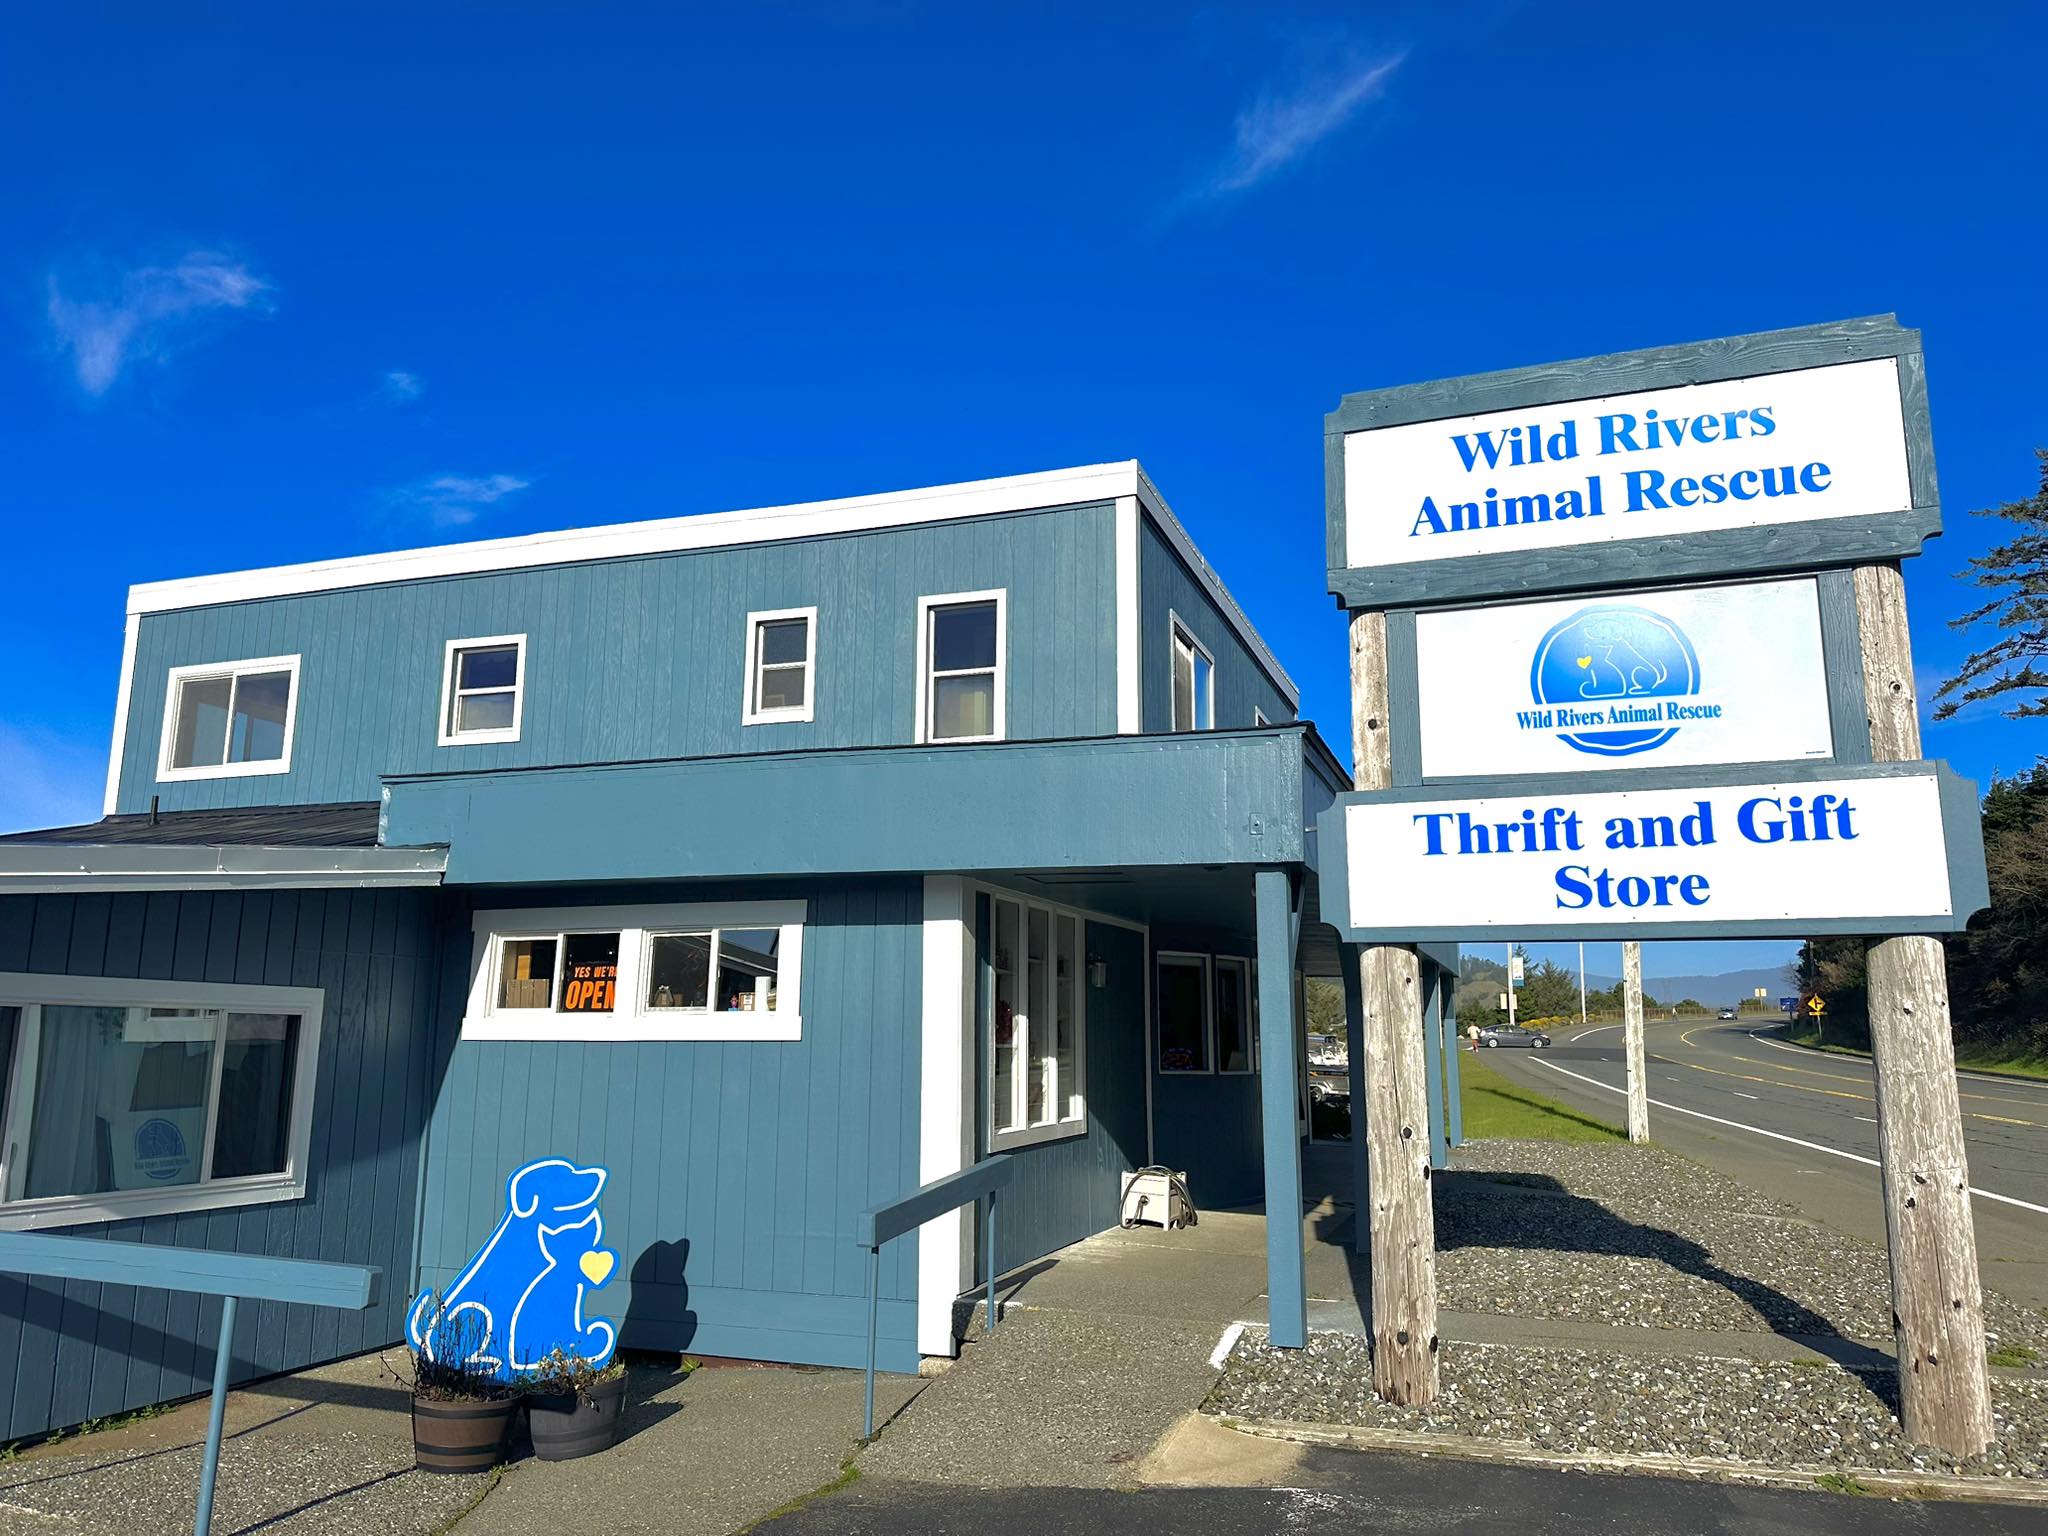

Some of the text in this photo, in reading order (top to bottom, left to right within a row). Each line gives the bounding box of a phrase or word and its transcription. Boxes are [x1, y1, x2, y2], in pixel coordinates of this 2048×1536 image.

[1450, 405, 1777, 473] Wild Rivers
[1408, 461, 1832, 538] Animal Rescue
[1516, 701, 1722, 730] Wild Rivers Animal Rescue
[1412, 794, 1860, 857] Thrift and Gift
[1554, 865, 1712, 910] Store
[574, 966, 591, 978] YES
[565, 980, 615, 1010] OPEN
